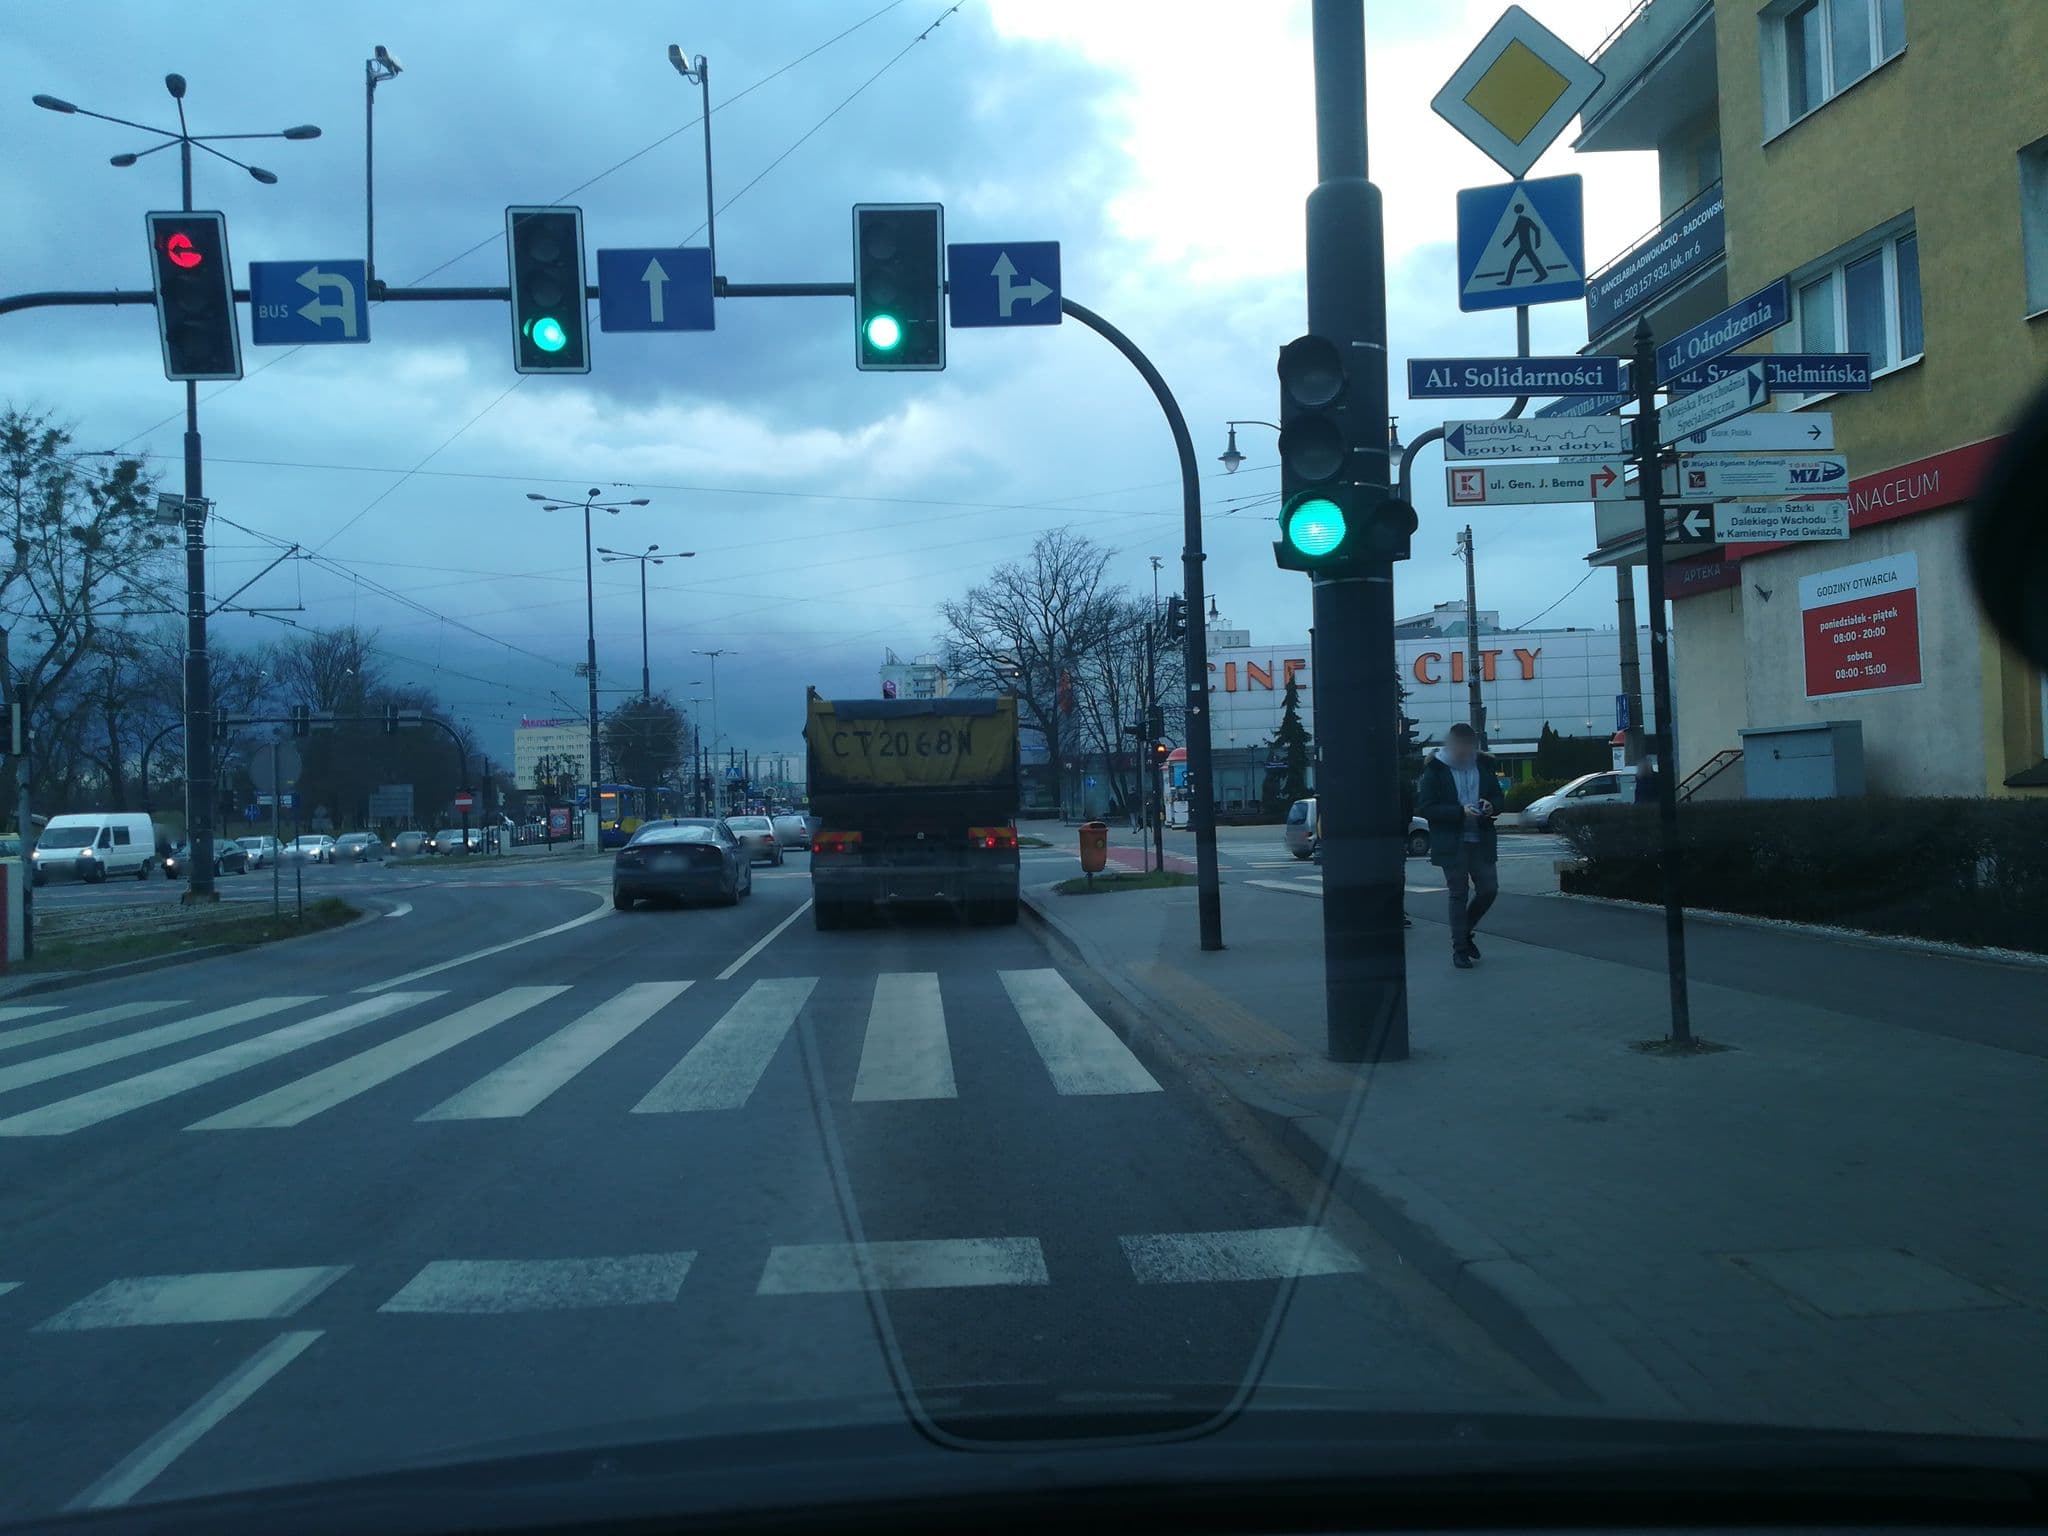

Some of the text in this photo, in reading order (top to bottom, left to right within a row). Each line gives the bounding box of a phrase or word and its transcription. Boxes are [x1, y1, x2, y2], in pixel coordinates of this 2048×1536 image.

[1613, 296, 1624, 310] tel.
[1625, 284, 1638, 302] 503
[1639, 274, 1651, 293] 157
[1684, 249, 1694, 262] nr
[1694, 240, 1701, 255] 6
[258, 304, 289, 318] BUS
[1668, 302, 1773, 370] ul. Odrodzenia
[1425, 366, 1604, 388] Al. Solidarności
[1465, 423, 1524, 435] Starówka
[1467, 444, 1521, 456] gotyk
[1559, 440, 1615, 453] dotyk
[1490, 481, 1504, 490] ul.
[1508, 479, 1535, 489] Gen.
[1539, 478, 1548, 489] J.
[1846, 470, 1940, 516] ANACEUM
[1731, 516, 1826, 527] Dalekiego Wschodu
[1727, 529, 1777, 539] Kamienicy
[1780, 528, 1800, 537] Pod
[1802, 527, 1843, 537] Gwiazdą
[1682, 565, 1721, 583] APTEKA
[1817, 571, 1898, 598] GODZINY OTWARCIA
[1819, 613, 1867, 633] poniedziałek
[1872, 607, 1898, 624] piątek
[1833, 632, 1857, 644] 08:00
[1862, 626, 1886, 640] 20:00
[1847, 651, 1873, 662] sobota
[1413, 647, 1542, 685] CITY
[1835, 667, 1858, 680] 08:00
[1865, 663, 1887, 676] 15:00
